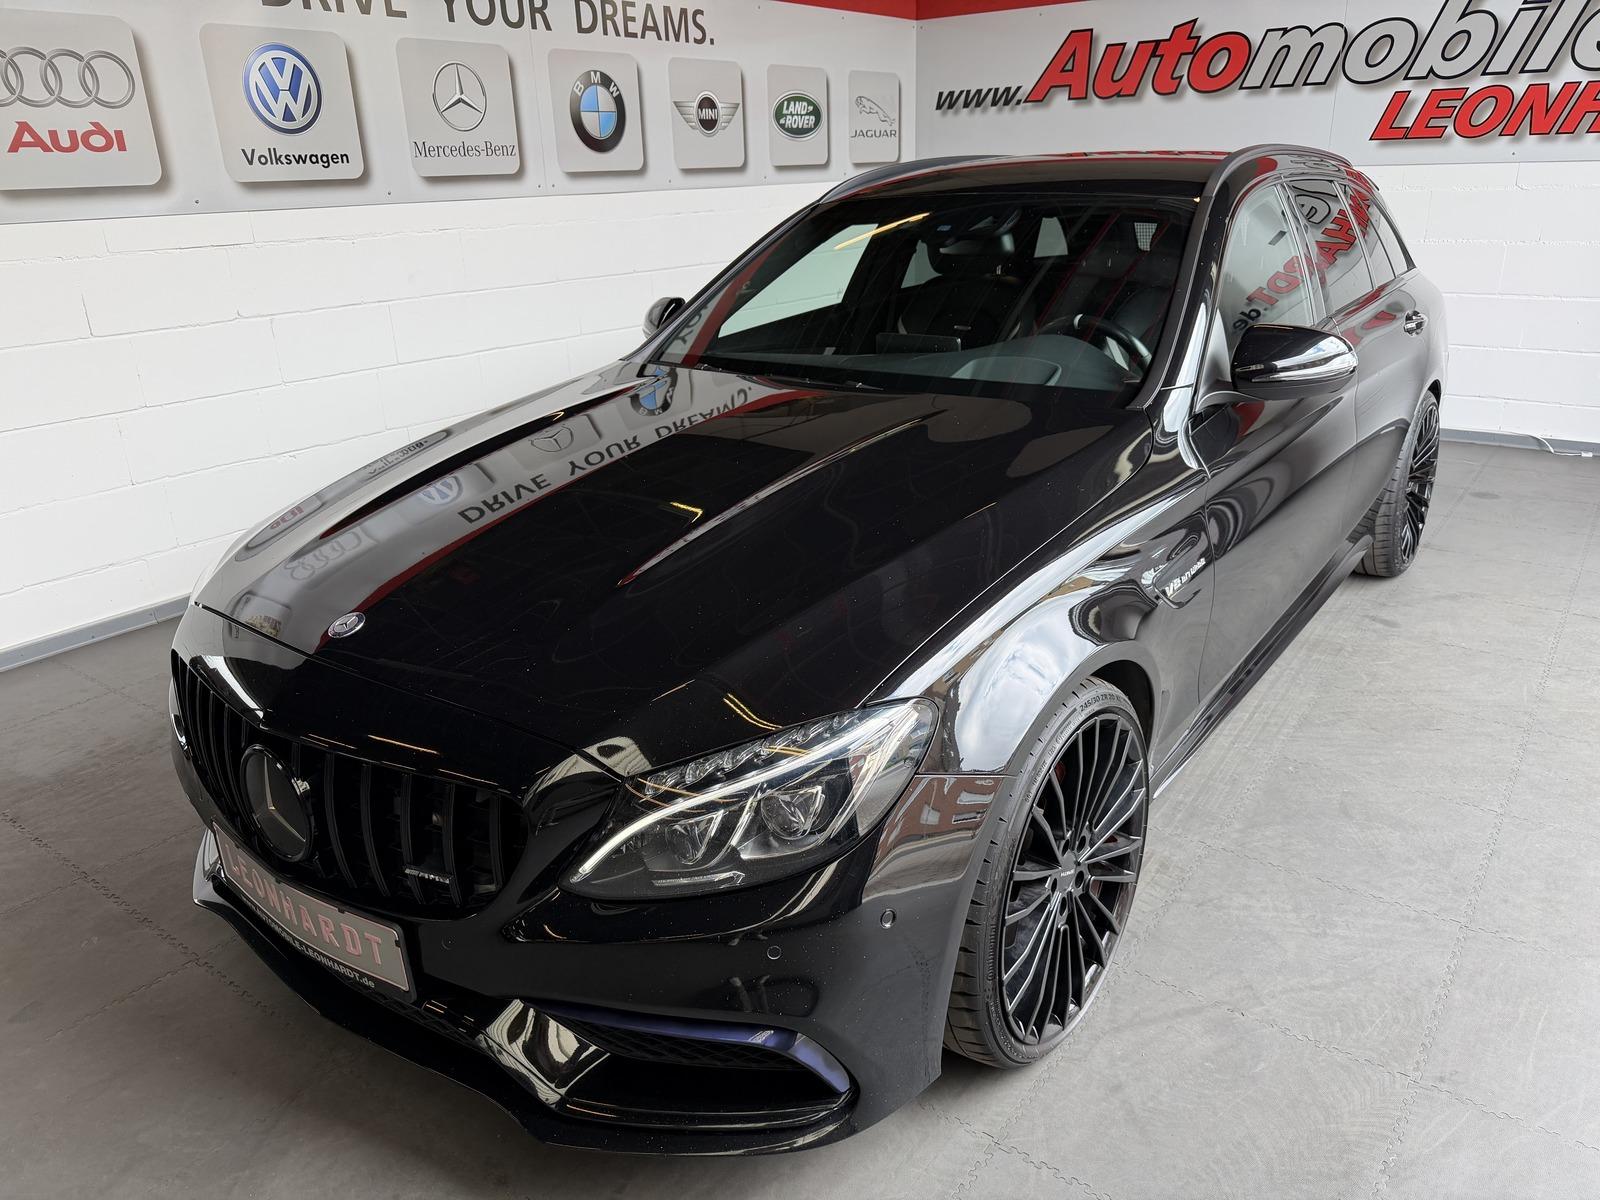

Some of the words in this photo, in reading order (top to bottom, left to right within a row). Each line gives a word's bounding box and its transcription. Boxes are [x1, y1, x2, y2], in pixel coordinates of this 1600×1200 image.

[574, 0, 715, 46] DREAMS.
[573, 71, 620, 97] BMW
[697, 108, 718, 121] MINI
[782, 101, 807, 114] LAND
[784, 115, 815, 129] ROVER
[7, 121, 127, 154] Audi
[851, 129, 898, 139] JAGUAR
[241, 147, 350, 169] Volkswagen
[413, 140, 517, 158] Mercedes-Benz
[225, 843, 383, 966] LEONHARDT
